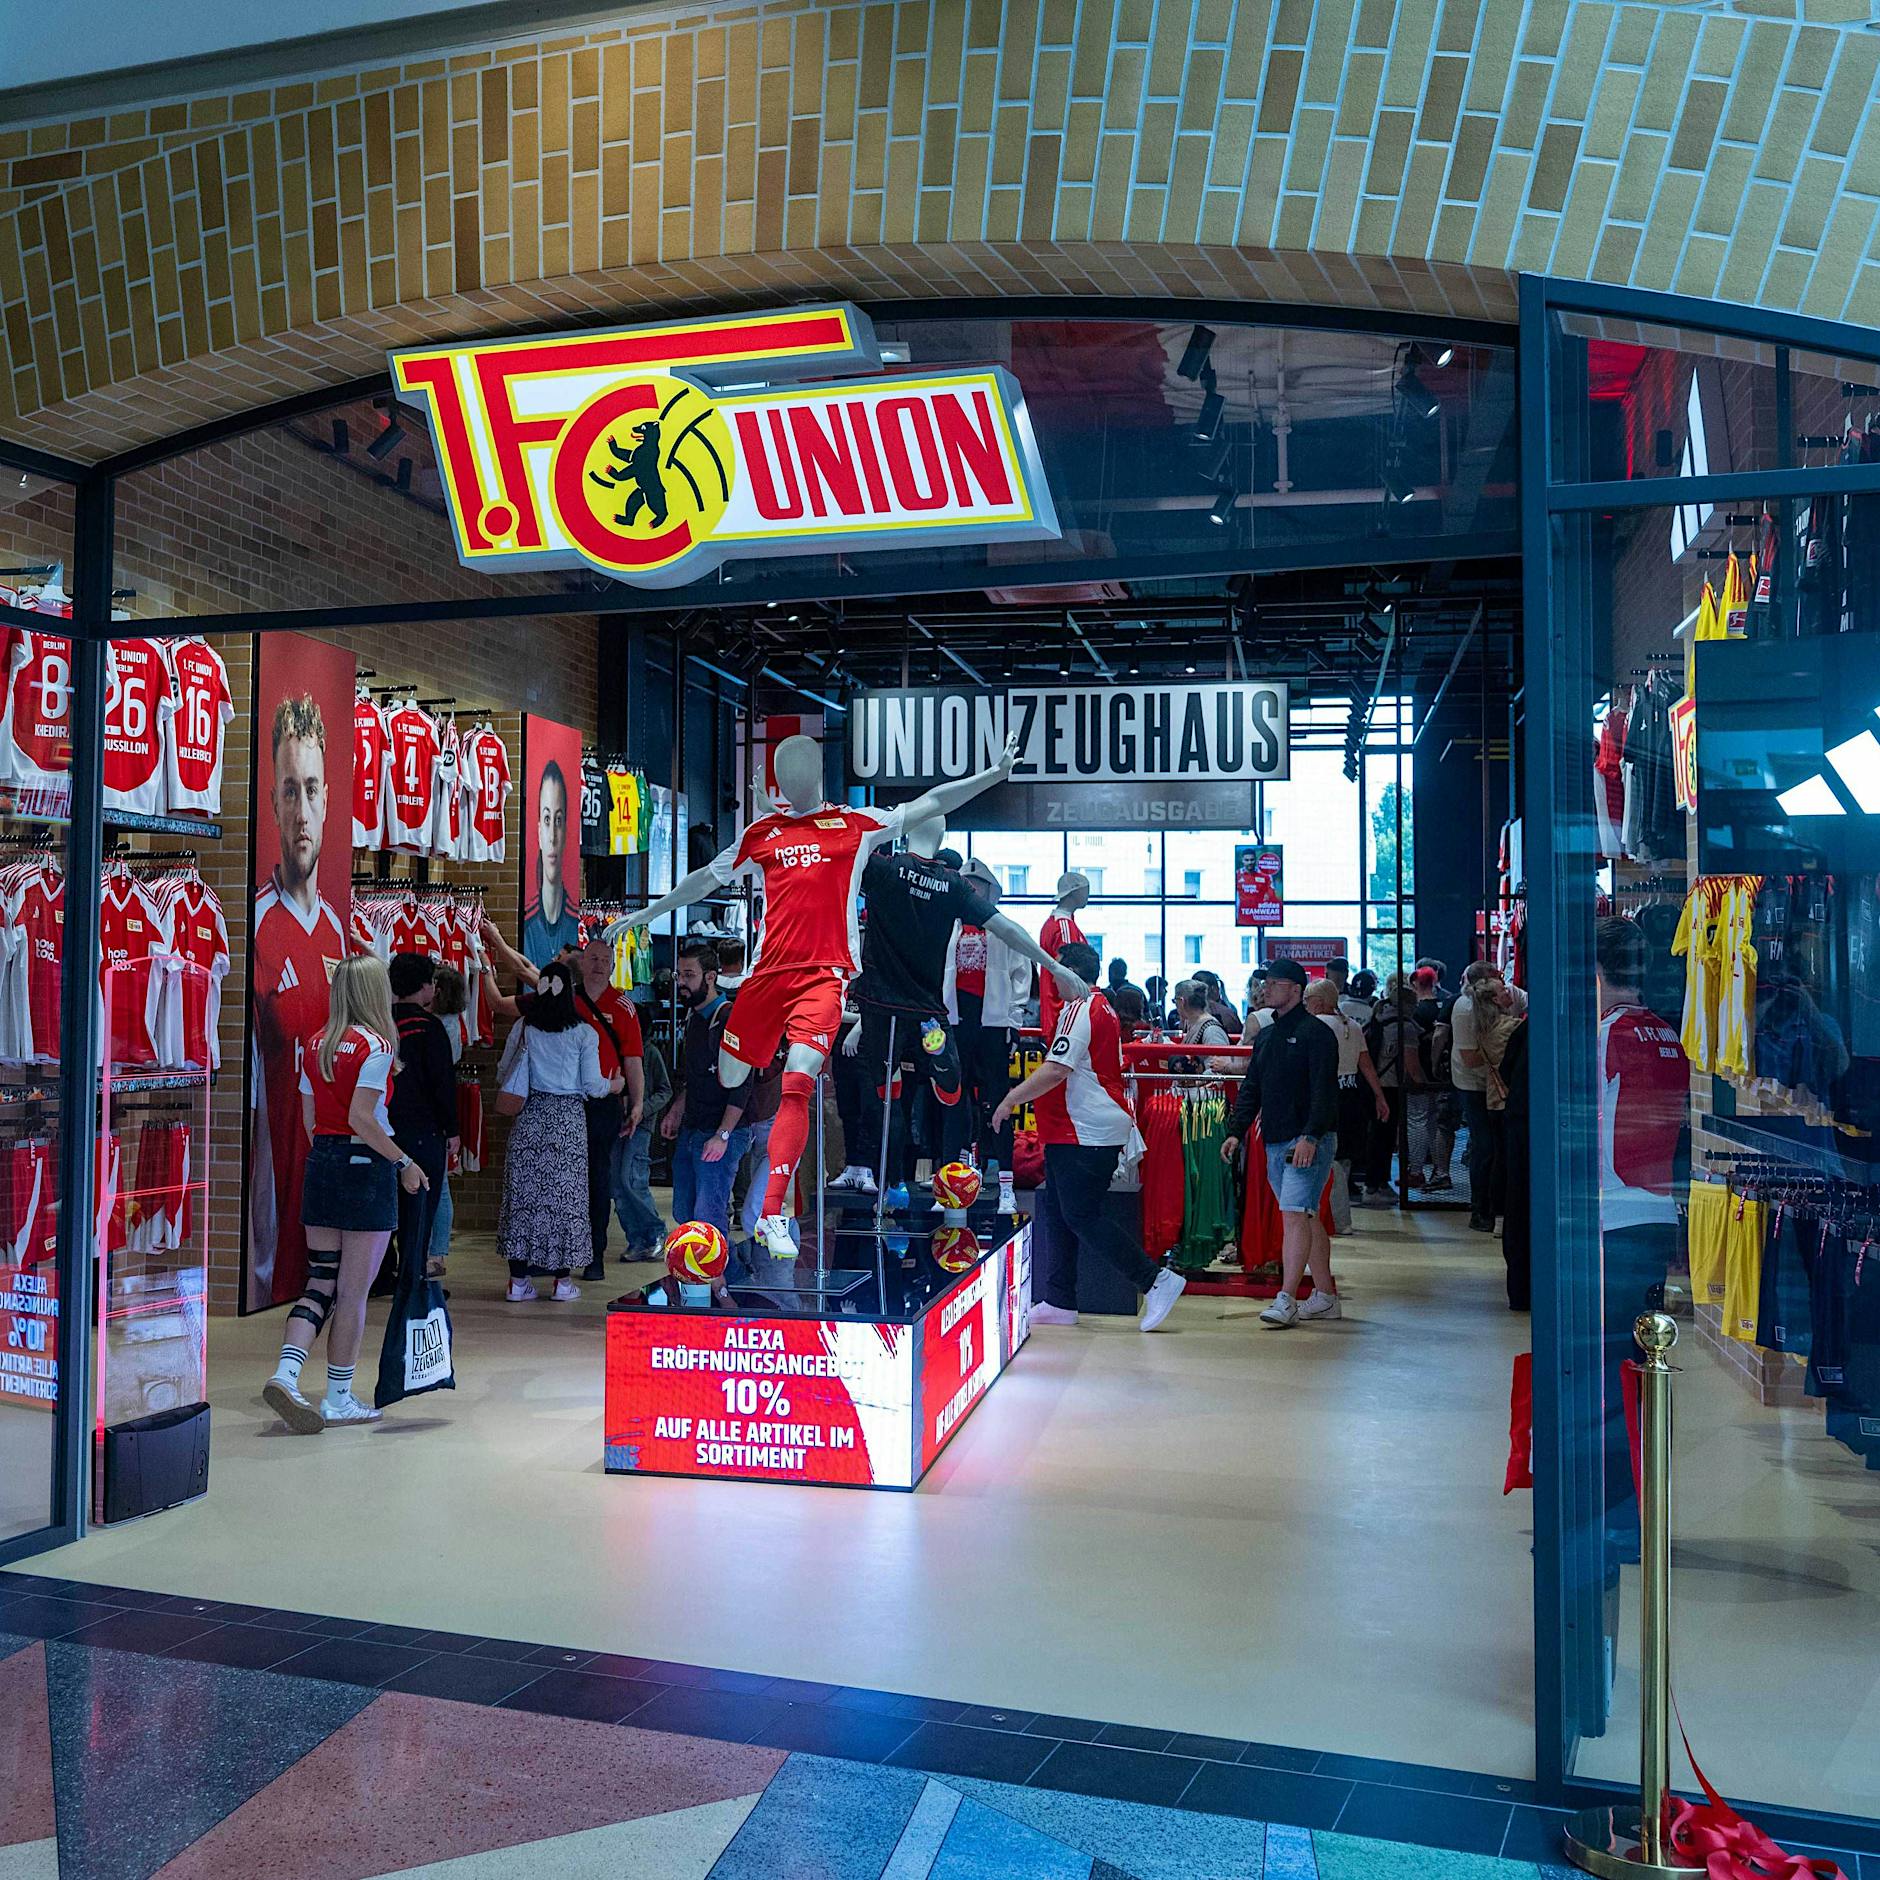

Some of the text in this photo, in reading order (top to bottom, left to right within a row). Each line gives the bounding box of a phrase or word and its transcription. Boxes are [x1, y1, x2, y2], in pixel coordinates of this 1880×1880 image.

[734, 391, 1014, 520] UNION
[43, 641, 65, 650] BERLIN
[121, 650, 148, 664] UNION
[41, 656, 69, 719] 8
[104, 678, 147, 737] 26
[186, 686, 211, 746] 16
[404, 746, 419, 792] 4
[582, 788, 601, 818] 36
[616, 796, 632, 824] 14
[775, 844, 820, 859] home
[783, 853, 798, 868] to
[899, 867, 950, 893] 1. FC UNION
[909, 886, 932, 900] BERLIN
[1274, 950, 1336, 958] FANARTIKEL
[1634, 1026, 1648, 1042] 1.
[1659, 1047, 1678, 1058] BERLIN
[724, 1328, 785, 1350] ALEXA
[652, 1345, 858, 1379] ERÖFFNUNGSANGEB
[722, 1378, 791, 1417] 10%
[654, 1416, 854, 1448] AUF ALLE ARTIKEL IM
[696, 1443, 806, 1470] SORTIMENT
